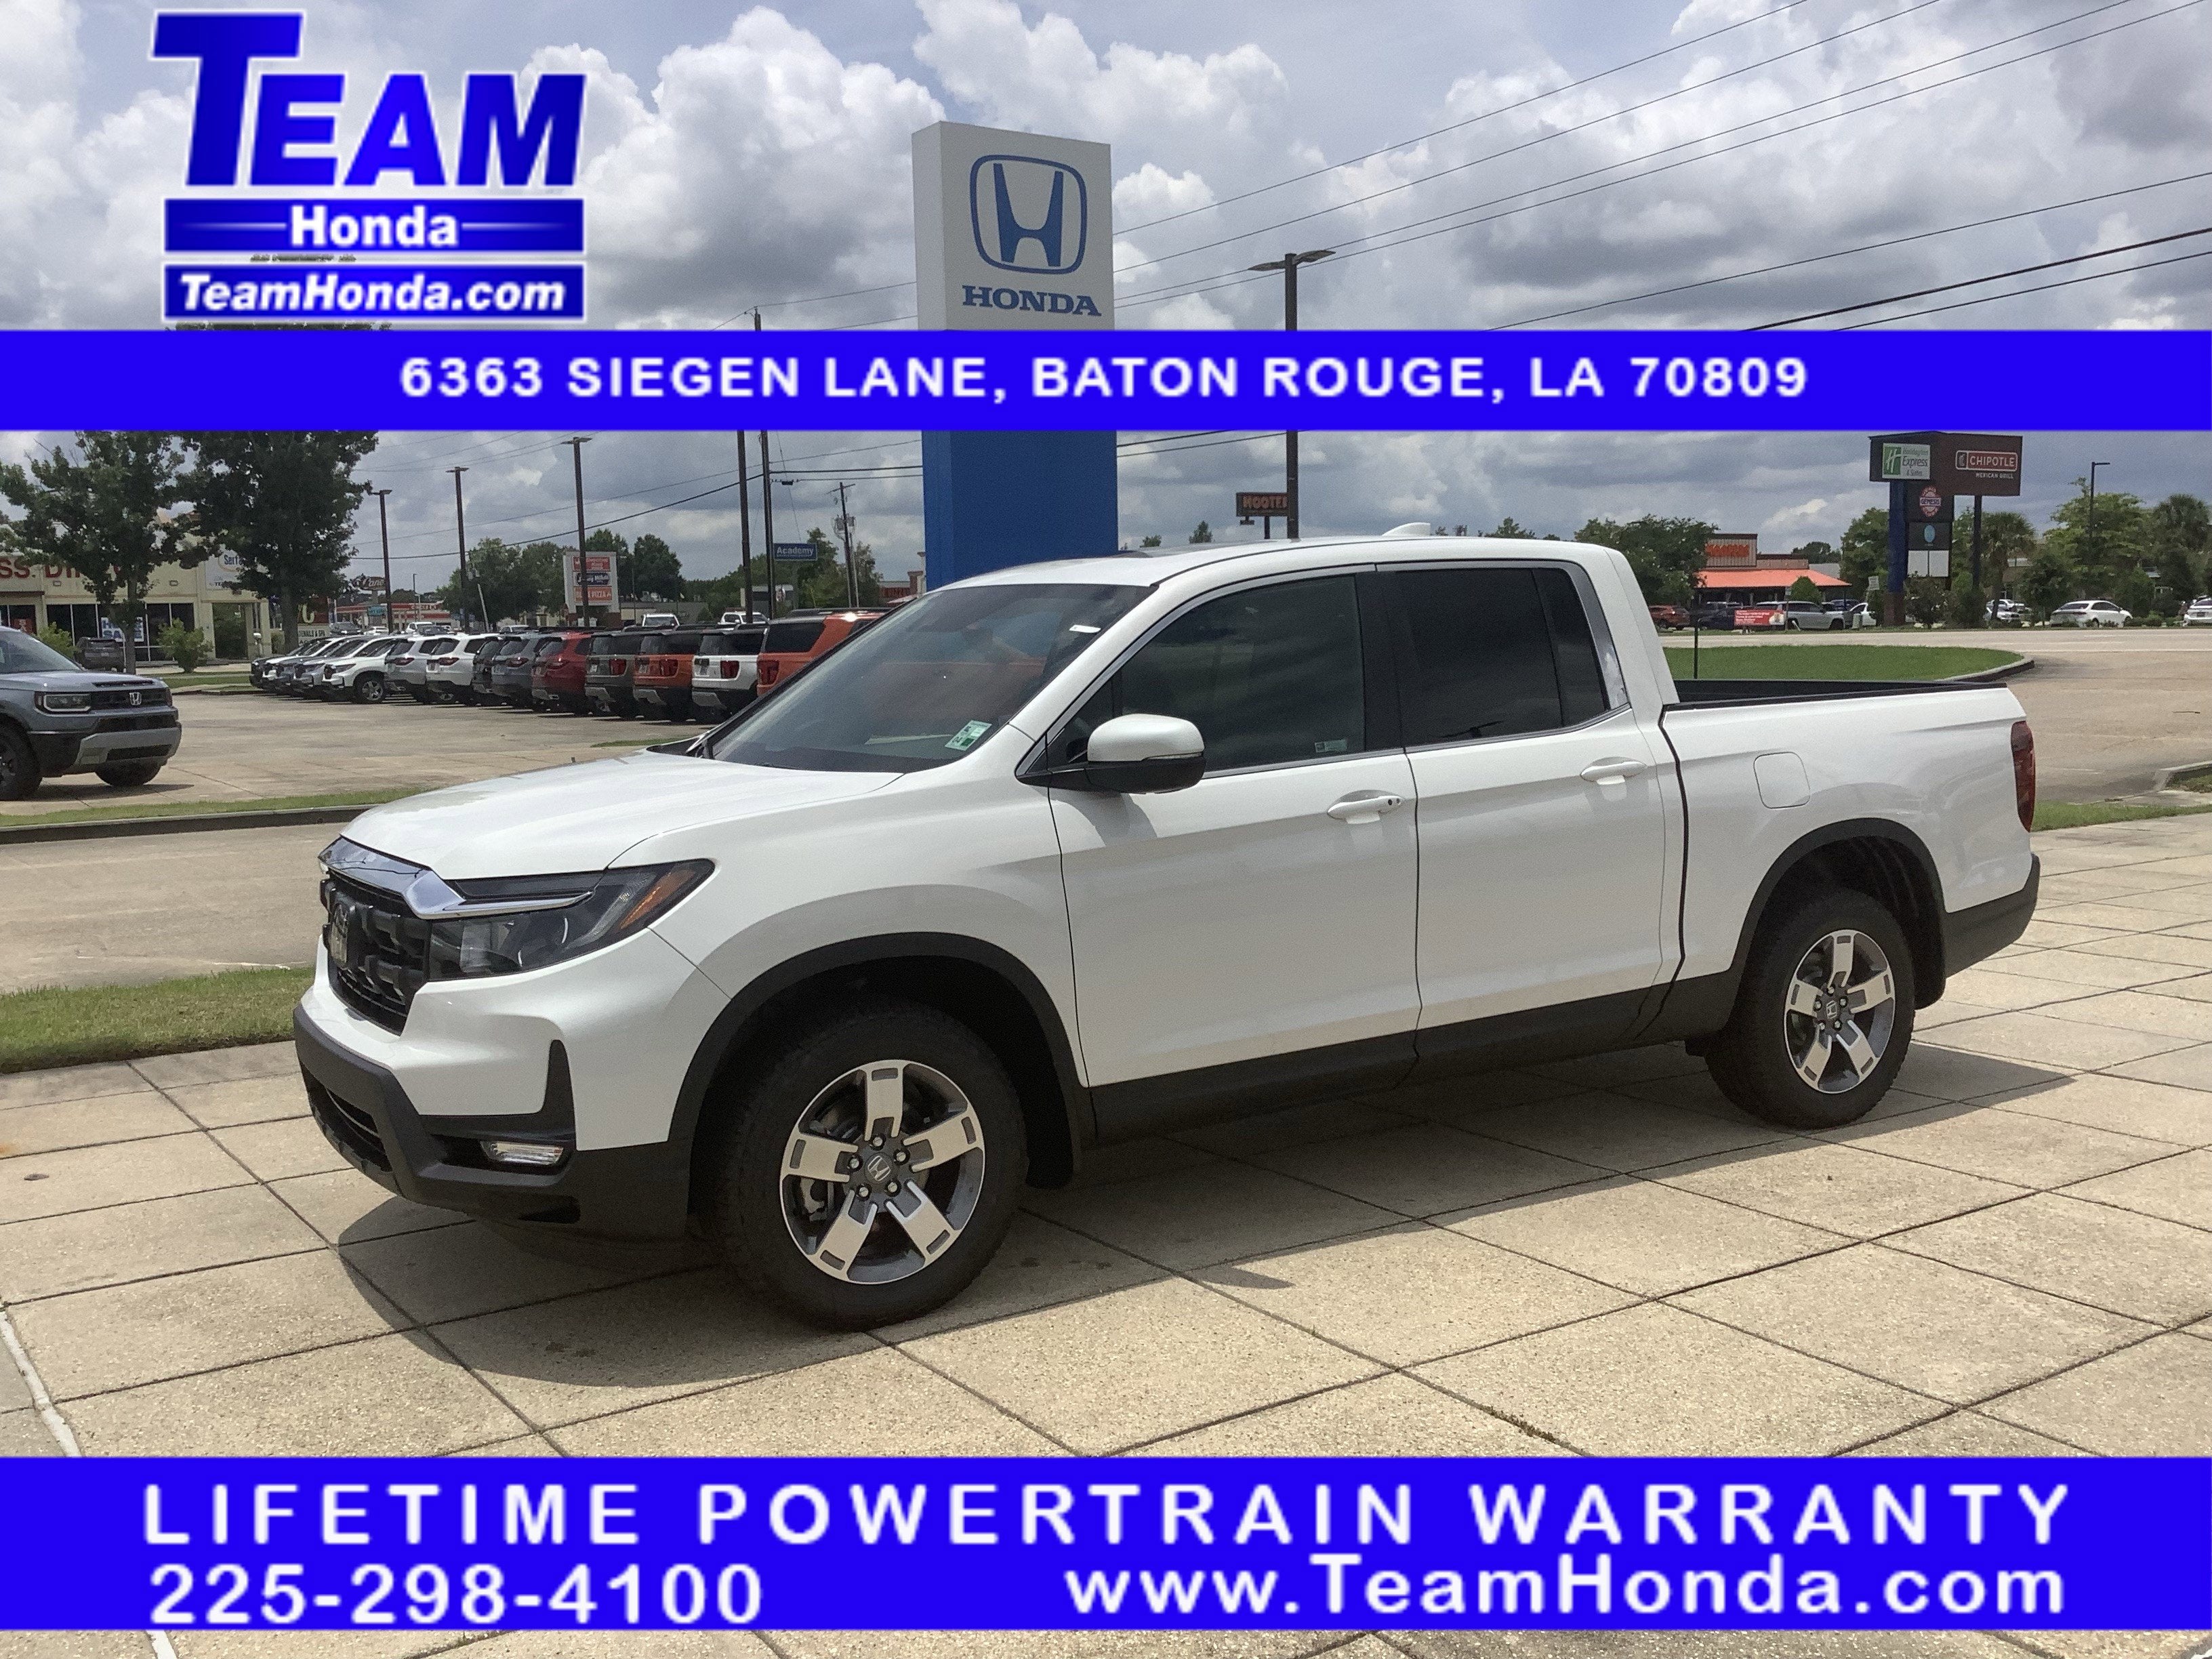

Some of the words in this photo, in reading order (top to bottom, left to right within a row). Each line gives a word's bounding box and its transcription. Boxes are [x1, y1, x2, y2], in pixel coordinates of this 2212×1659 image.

[962, 285, 1102, 316] HONDA
[1902, 455, 1928, 468] Express
[1969, 455, 2015, 467] CHIPOTLE
[1242, 495, 1287, 508] HOOTE
[777, 547, 814, 556] Academy
